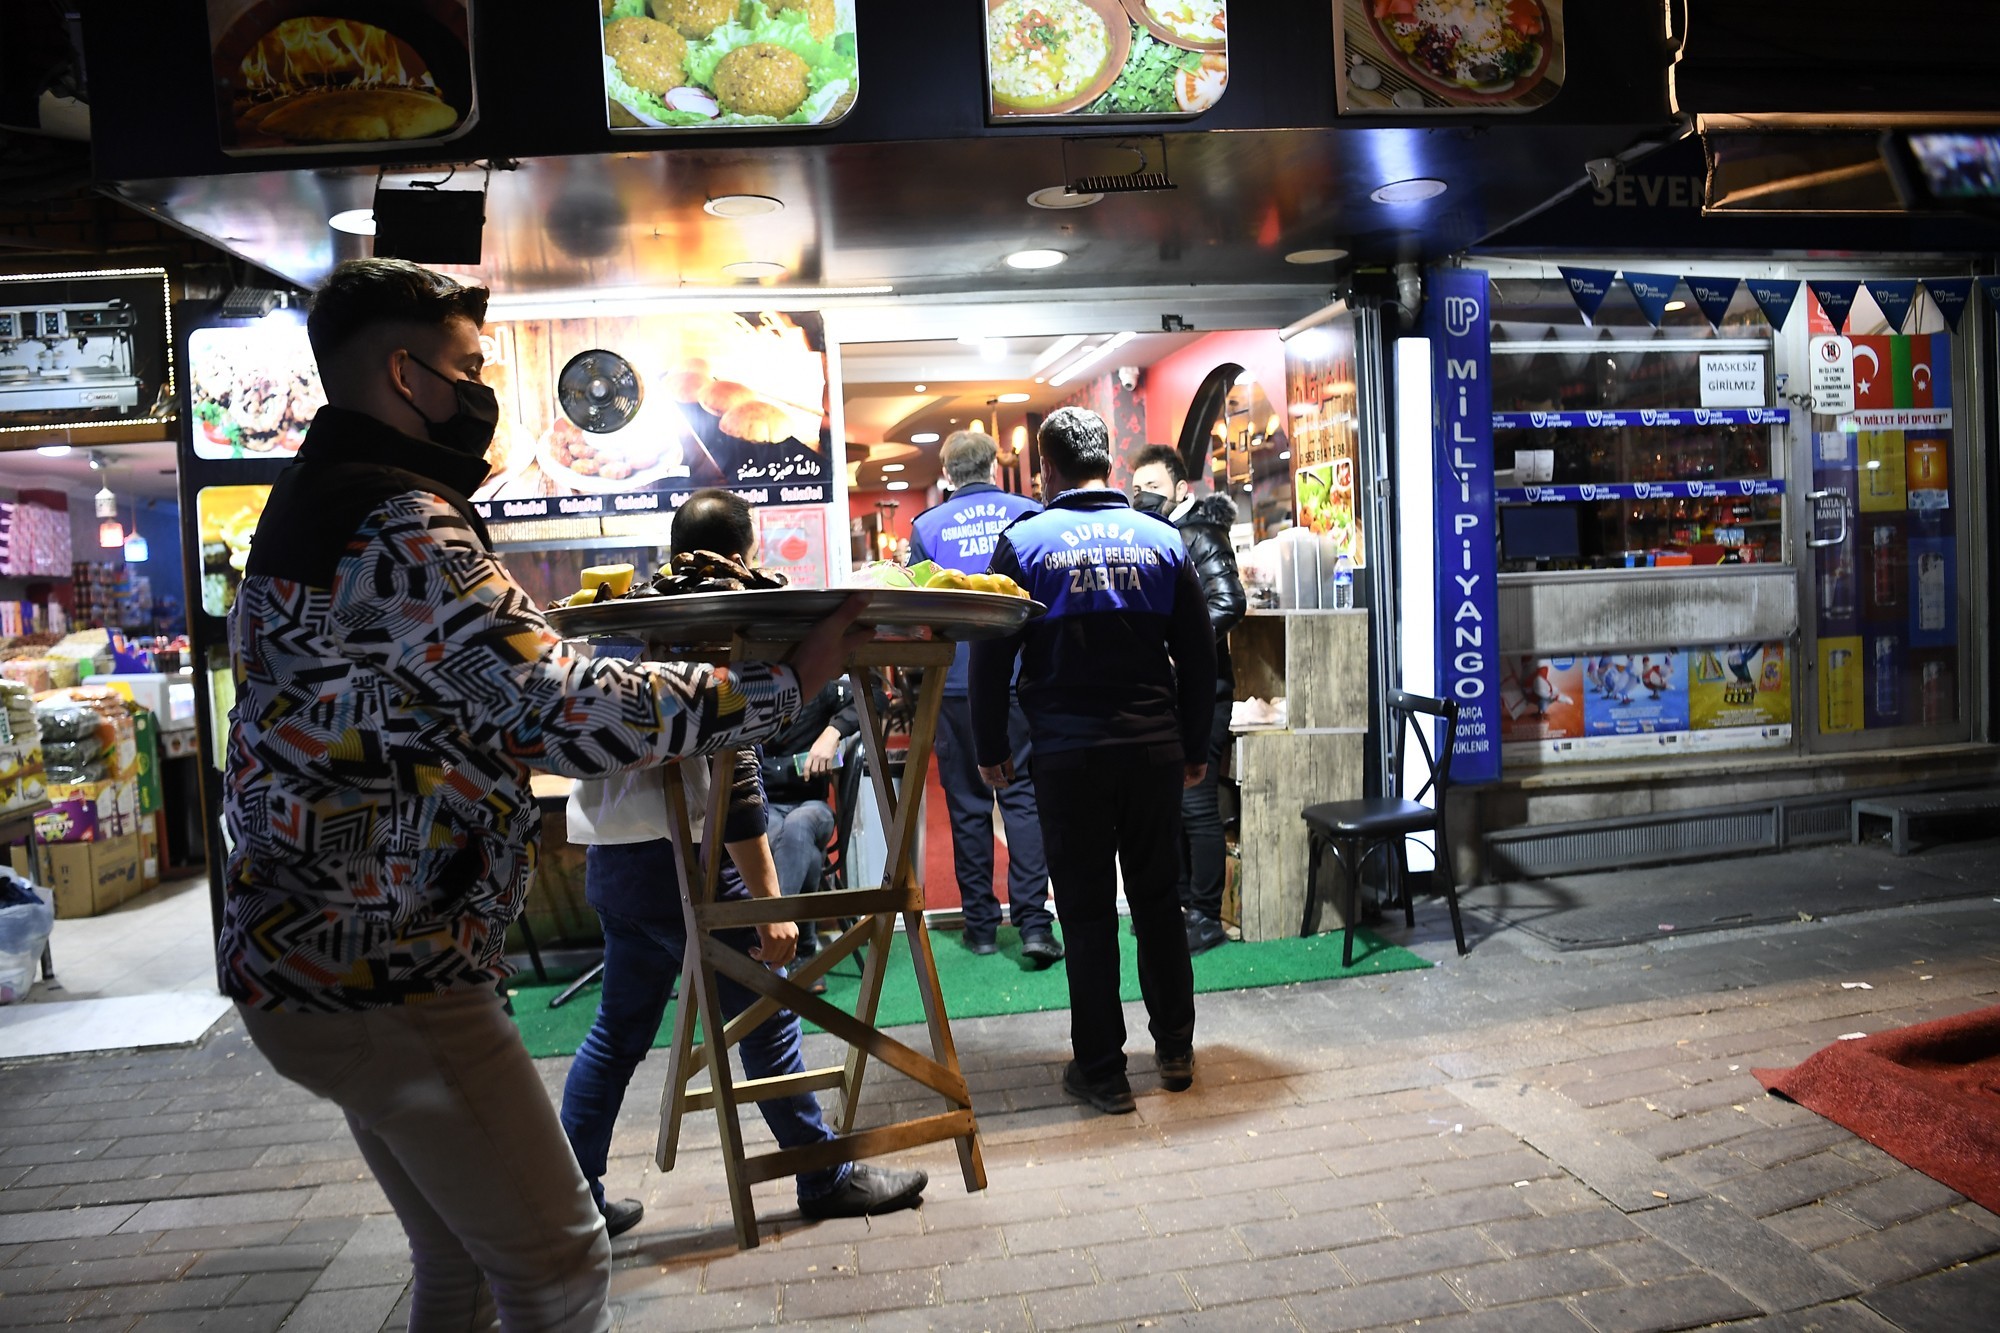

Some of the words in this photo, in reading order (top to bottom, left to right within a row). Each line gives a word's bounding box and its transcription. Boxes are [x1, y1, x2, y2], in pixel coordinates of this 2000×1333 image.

[1707, 362, 1757, 373] MASKESİZ
[1708, 379, 1756, 392] GİRİLMEZ
[1547, 413, 1561, 421] milli
[1602, 412, 1616, 420] milli
[1763, 416, 1786, 424] piyango
[1864, 413, 1894, 426] MİLLET
[1897, 412, 1909, 425] İKİ
[1547, 420, 1573, 428] piyango
[1602, 419, 1627, 427] piyango
[1657, 418, 1681, 426] piyango
[1710, 417, 1734, 425] piyango
[1650, 491, 1674, 499] piyango
[1755, 487, 1778, 495] piyango
[1541, 494, 1566, 502] piyango
[953, 503, 1007, 524] BURSA
[941, 519, 984, 541] OSMANGAZİ
[1060, 522, 1135, 548] BURSA
[958, 535, 1000, 558] ZABIT
[1045, 543, 1104, 571] OSMANGAZİ
[1069, 566, 1141, 594] ZABITA
[1457, 706, 1483, 721] PARÇA
